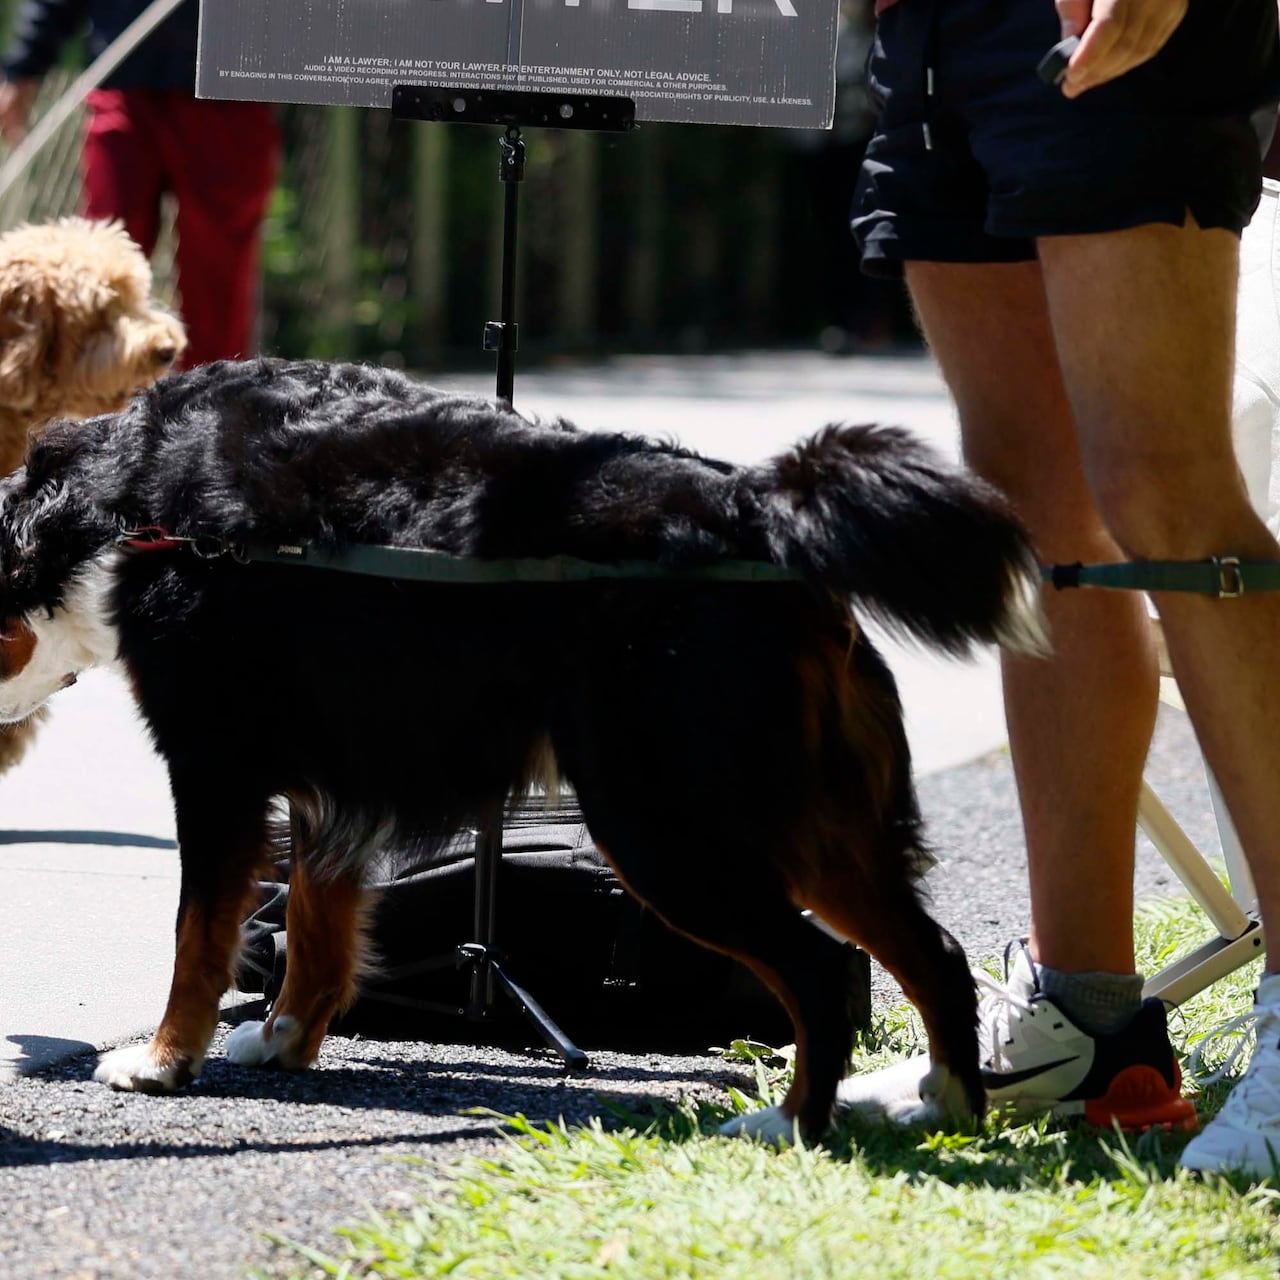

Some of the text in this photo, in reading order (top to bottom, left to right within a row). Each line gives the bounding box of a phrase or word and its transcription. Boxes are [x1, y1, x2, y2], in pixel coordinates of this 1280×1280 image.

[304, 64, 326, 72] AUDIO
[334, 65, 355, 73] VIDEO
[357, 67, 399, 76] RECORDING
[408, 70, 449, 78] PROGRESS.
[450, 72, 501, 80] INTERACTIONS
[571, 77, 590, 85] USED
[592, 78, 607, 86] FOR
[608, 79, 655, 88] COMMERCIAL
[688, 83, 728, 91] PURPOSES.
[329, 56, 342, 65] AM
[352, 57, 392, 67] LAWYER;
[399, 59, 413, 67] AM
[415, 60, 433, 69] NOT
[435, 61, 461, 70] YOUR
[502, 63, 519, 72] FOR
[521, 65, 594, 77] ENTERTAINMENT
[624, 70, 643, 79] NOT
[645, 71, 674, 81] LEGAL
[676, 72, 711, 82] ADVICE.
[230, 71, 267, 79] ENGAGING
[393, 80, 428, 88] ANSWERS
[439, 81, 480, 90] QUESTIONS
[481, 83, 495, 91] ARE
[497, 84, 531, 92] PROVIDED
[541, 86, 598, 96] CONSIDERATION
[615, 89, 628, 97] ALL
